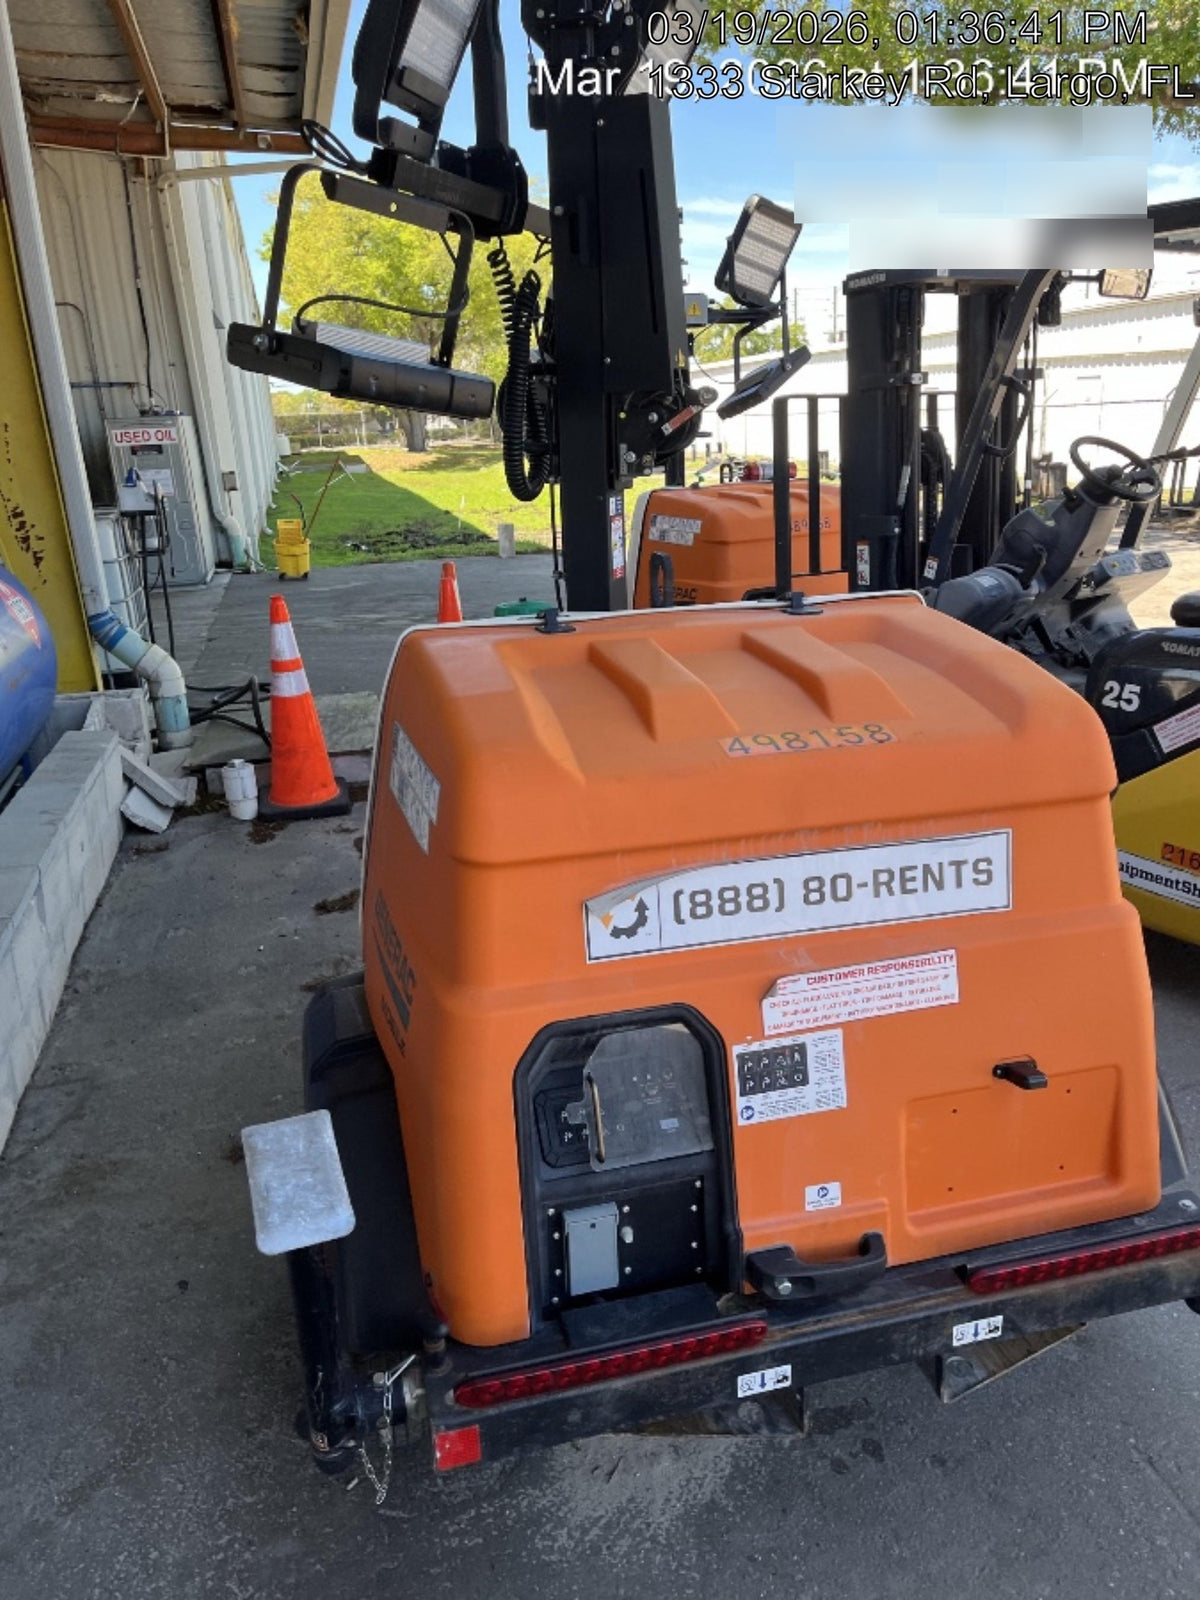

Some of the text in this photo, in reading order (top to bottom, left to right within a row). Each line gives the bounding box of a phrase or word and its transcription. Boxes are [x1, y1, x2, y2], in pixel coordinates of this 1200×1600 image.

[114, 429, 177, 443] USED OIL
[1101, 680, 1141, 712] 25
[728, 722, 894, 755] 498158
[673, 856, 994, 926] (888) 80-RENTS
[806, 968, 866, 986] CUSTOMER
[867, 953, 955, 977] RESPONSIBILITY
